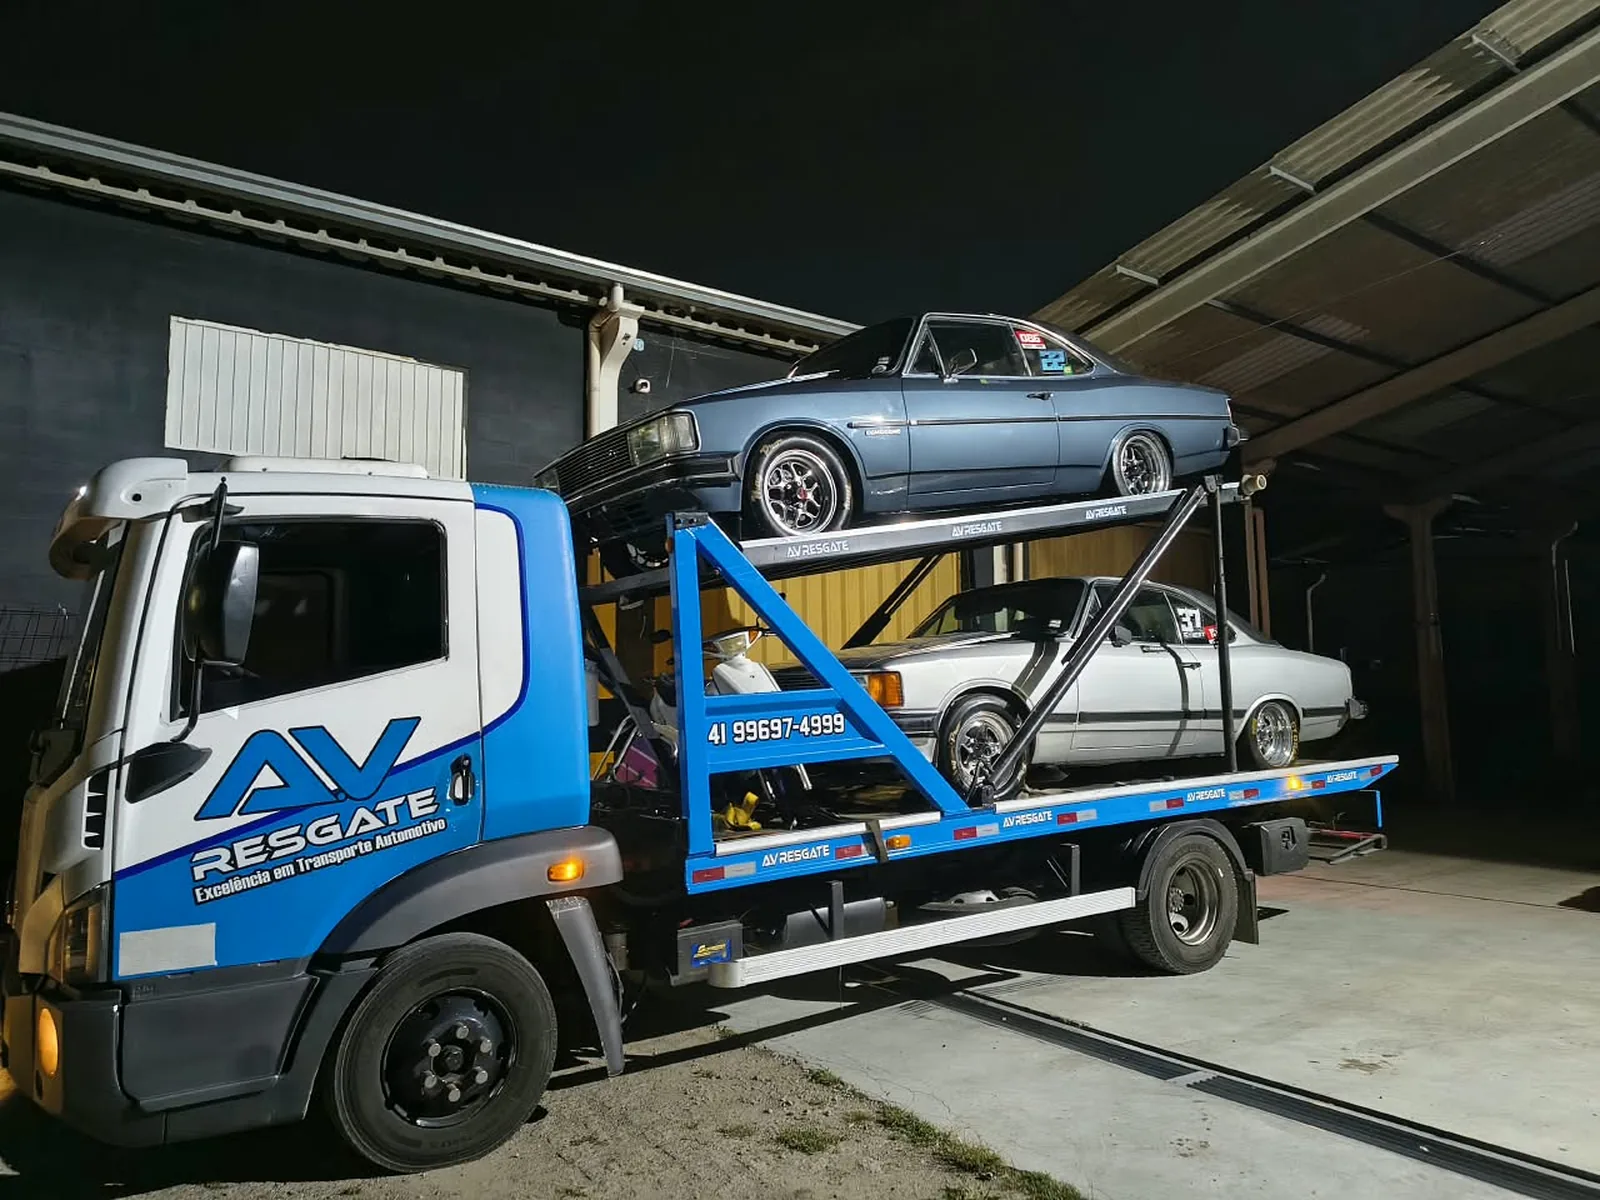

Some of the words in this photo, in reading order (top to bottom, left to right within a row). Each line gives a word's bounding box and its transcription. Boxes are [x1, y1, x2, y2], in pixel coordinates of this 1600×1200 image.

[194, 716, 422, 821] AV
[708, 722, 727, 745] 41
[732, 712, 845, 743] 99697-4999
[191, 787, 439, 882] RESGATE
[194, 869, 271, 904] Excelência
[273, 864, 296, 880] em
[295, 840, 374, 873] Transporte
[374, 818, 446, 850] Automotivo
